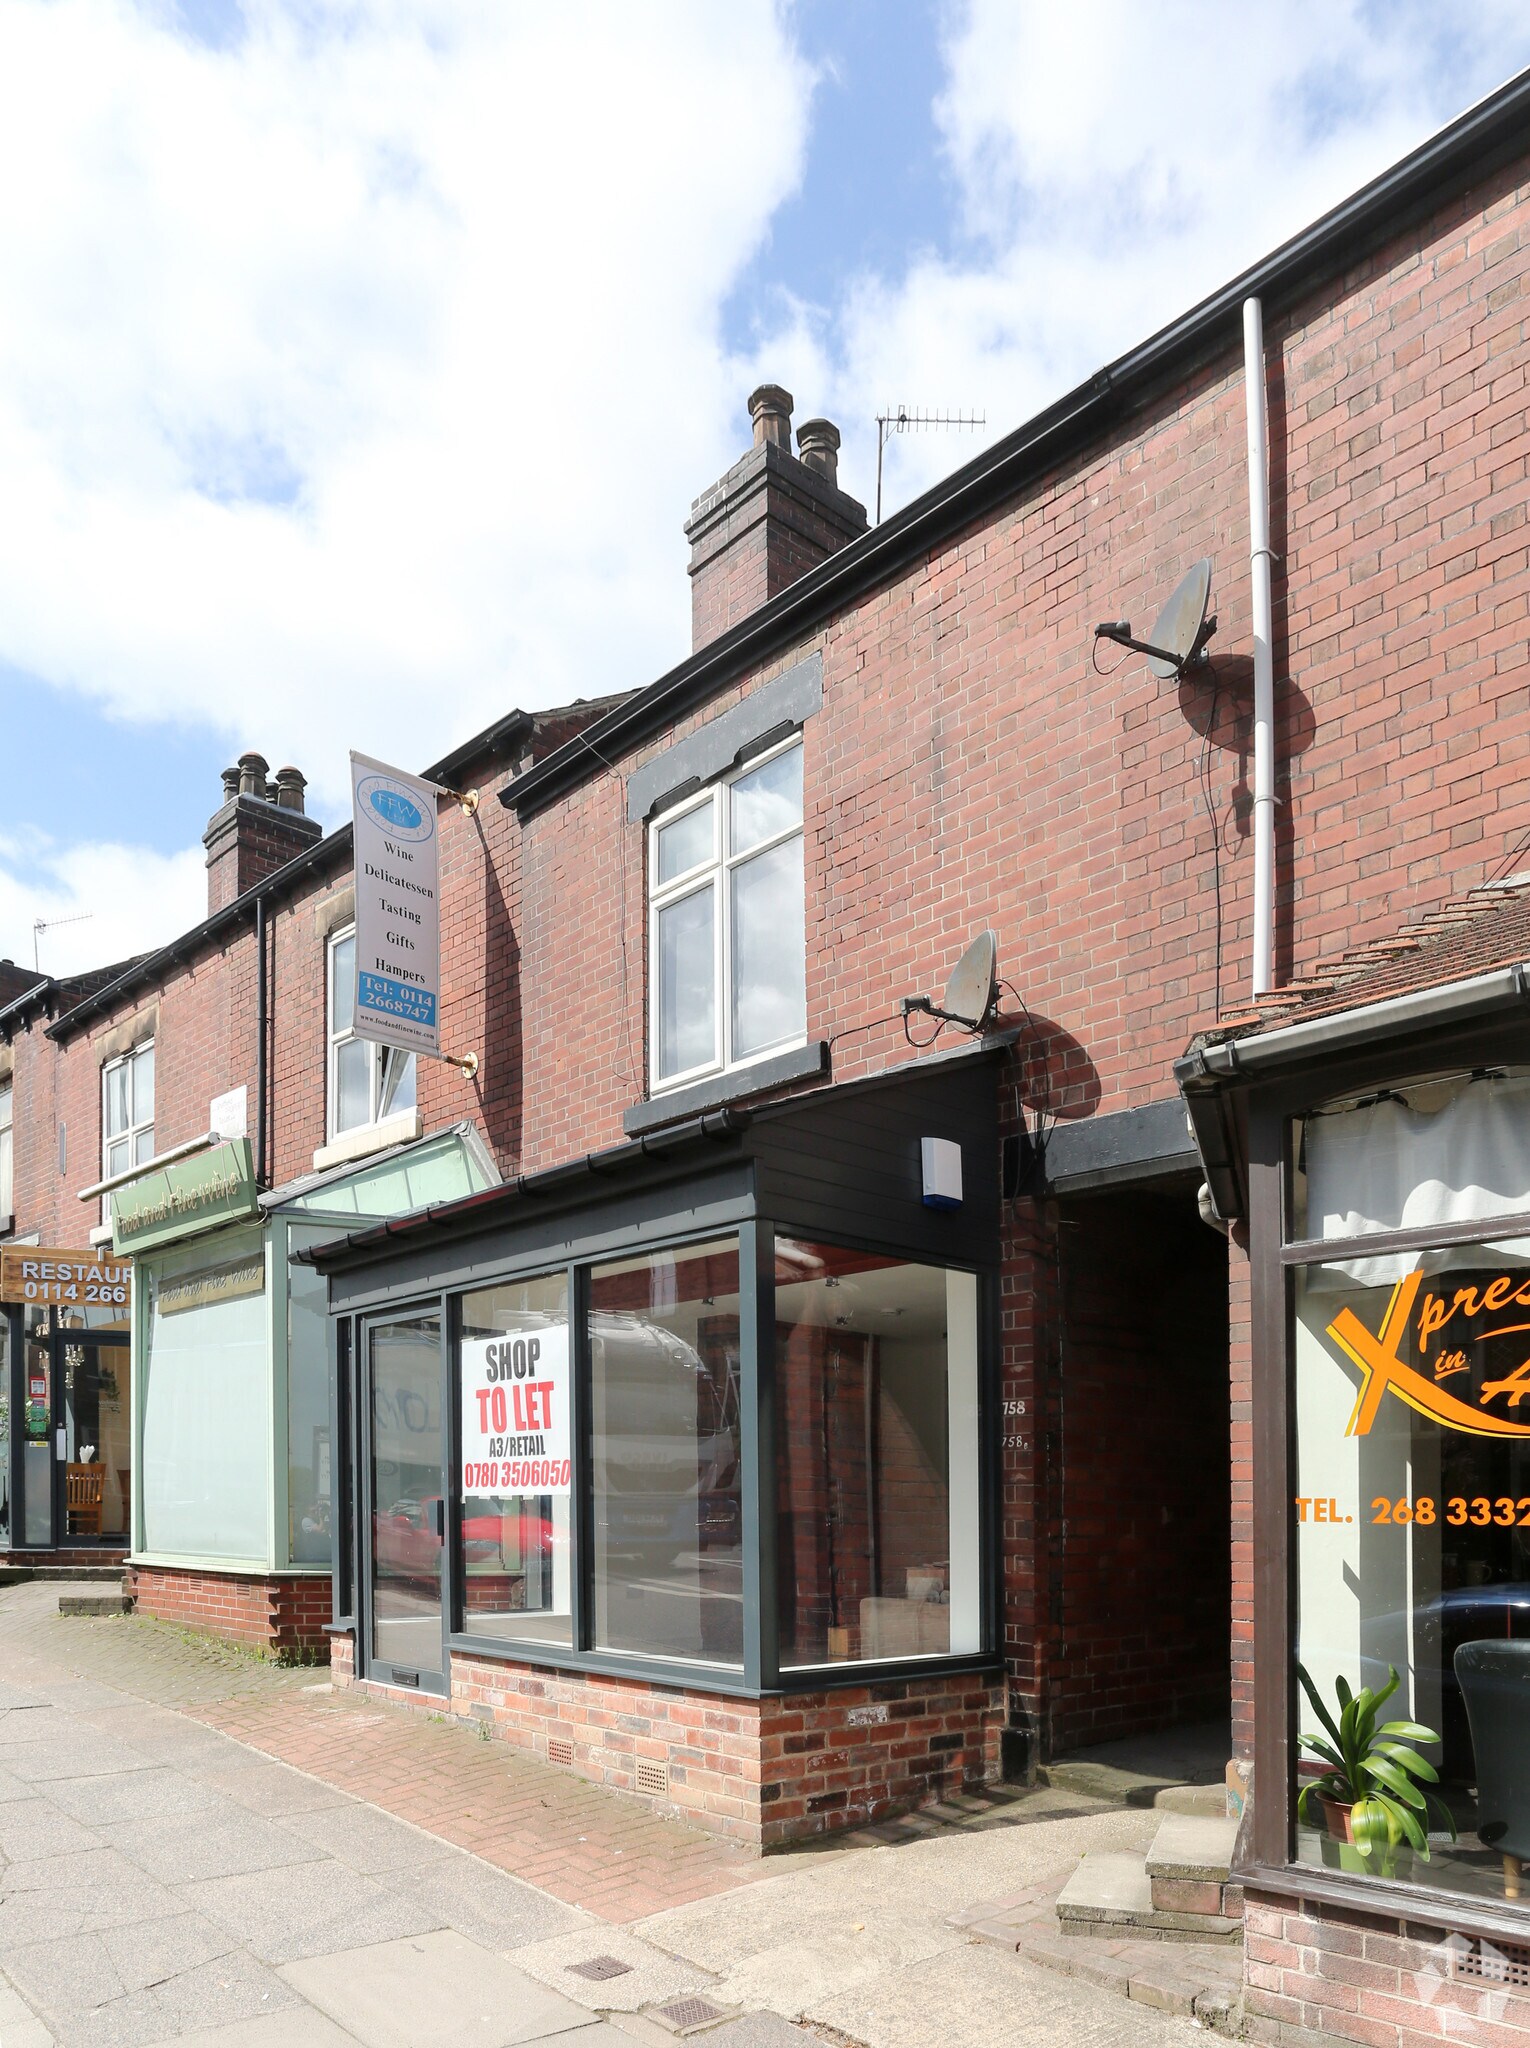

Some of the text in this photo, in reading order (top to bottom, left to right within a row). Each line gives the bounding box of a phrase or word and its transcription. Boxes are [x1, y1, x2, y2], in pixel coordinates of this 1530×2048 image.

[377, 792, 416, 818] FFW
[384, 841, 414, 862] Wine
[364, 863, 434, 899] Delicatessen
[379, 898, 421, 925] Tasting
[386, 931, 415, 951] Gifts
[375, 957, 425, 984] Hampers
[363, 976, 432, 1007] Tel: 0114
[366, 992, 429, 1020] 2668747
[360, 1014, 435, 1039] www.foodandfinewine.com
[24, 1281, 126, 1303] 0114 266
[486, 1338, 540, 1382] SHOP
[1434, 1350, 1470, 1380] in
[476, 1386, 508, 1433] TO
[513, 1381, 554, 1431] LET
[1002, 1400, 1025, 1415] 758
[489, 1435, 546, 1457] A3/RETAIL
[465, 1459, 571, 1488] 0780 3506050
[1295, 1498, 1353, 1523] TEL.
[1371, 1497, 1436, 1525] 268
